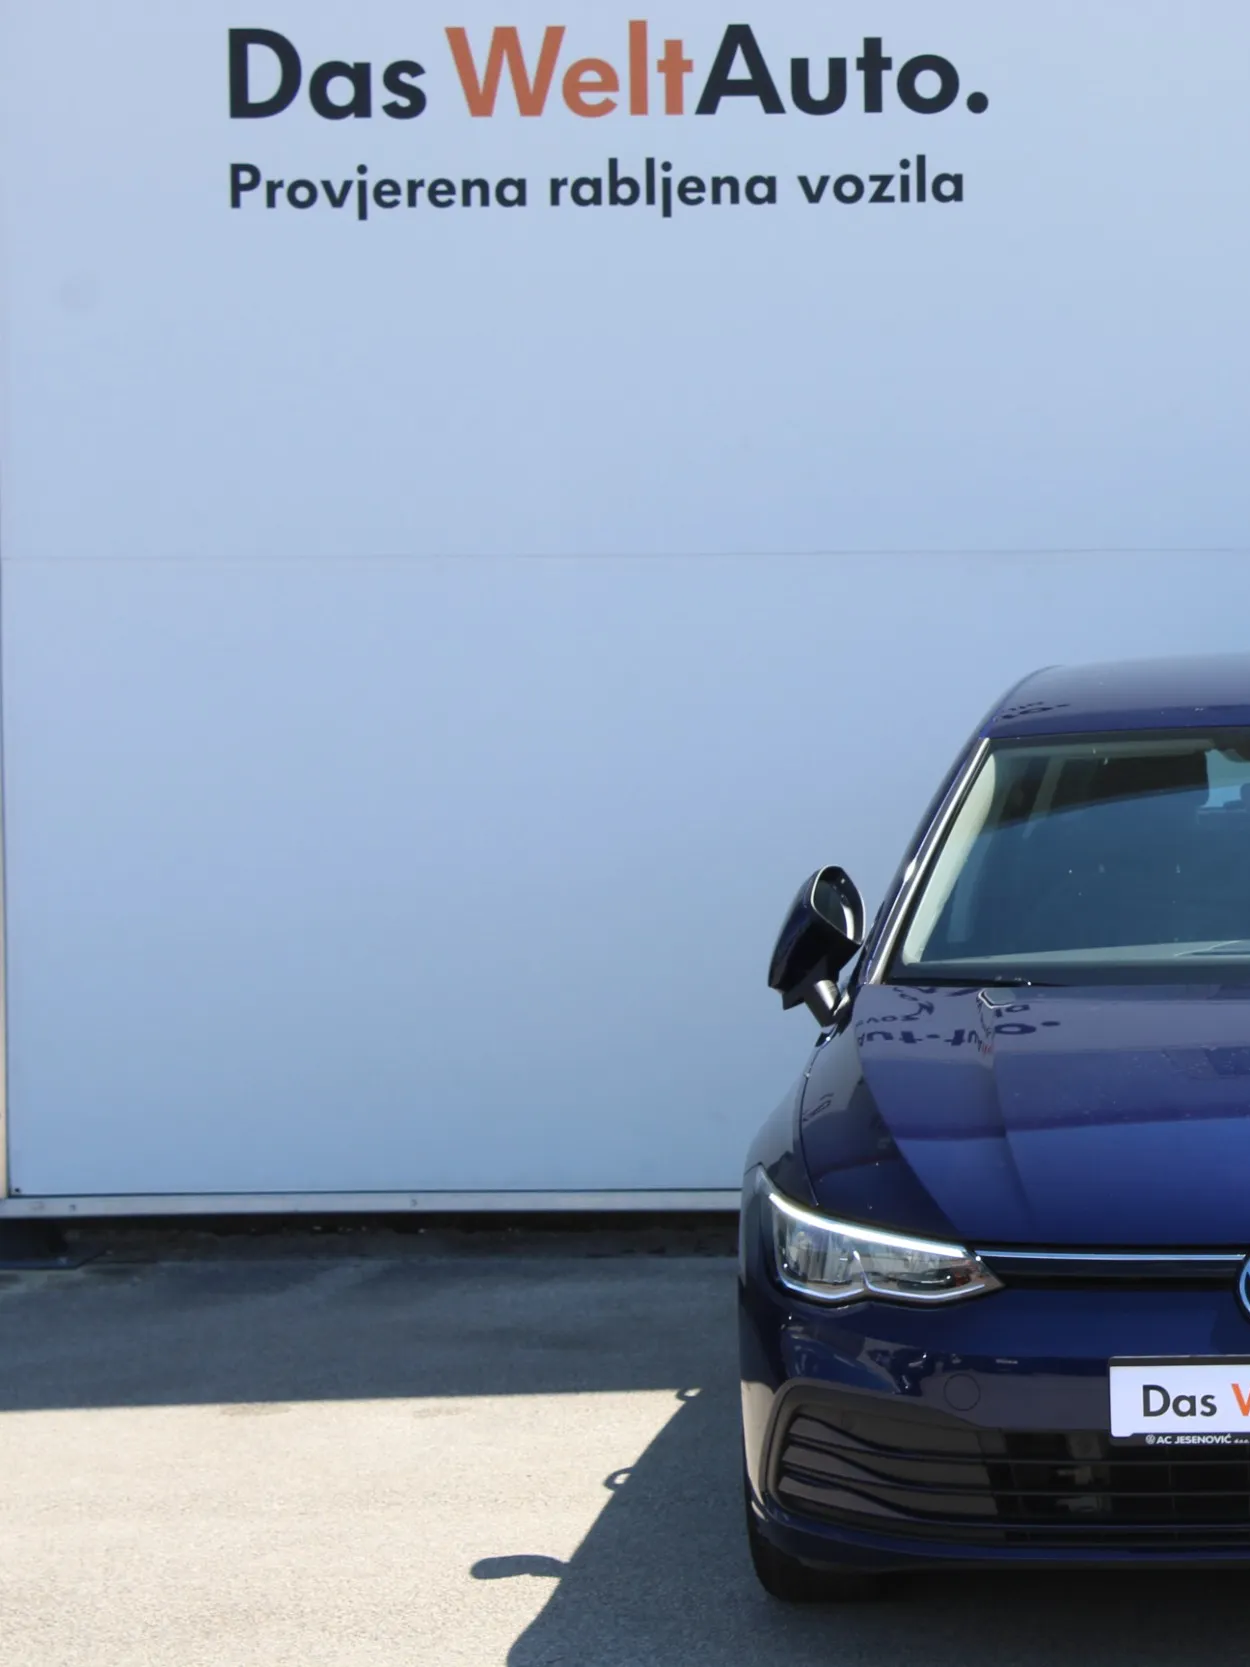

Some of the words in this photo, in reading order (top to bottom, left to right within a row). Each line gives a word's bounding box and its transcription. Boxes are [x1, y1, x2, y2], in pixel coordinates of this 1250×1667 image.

[228, 27, 427, 121] Das
[445, 19, 989, 119] WeltAuto.
[229, 162, 527, 221] Provjerena
[549, 156, 777, 219] rabljena
[797, 153, 964, 205] vozila
[1142, 1384, 1218, 1418] Das
[1156, 1435, 1172, 1445] AC
[1174, 1433, 1232, 1445] JESENOVIĆ
